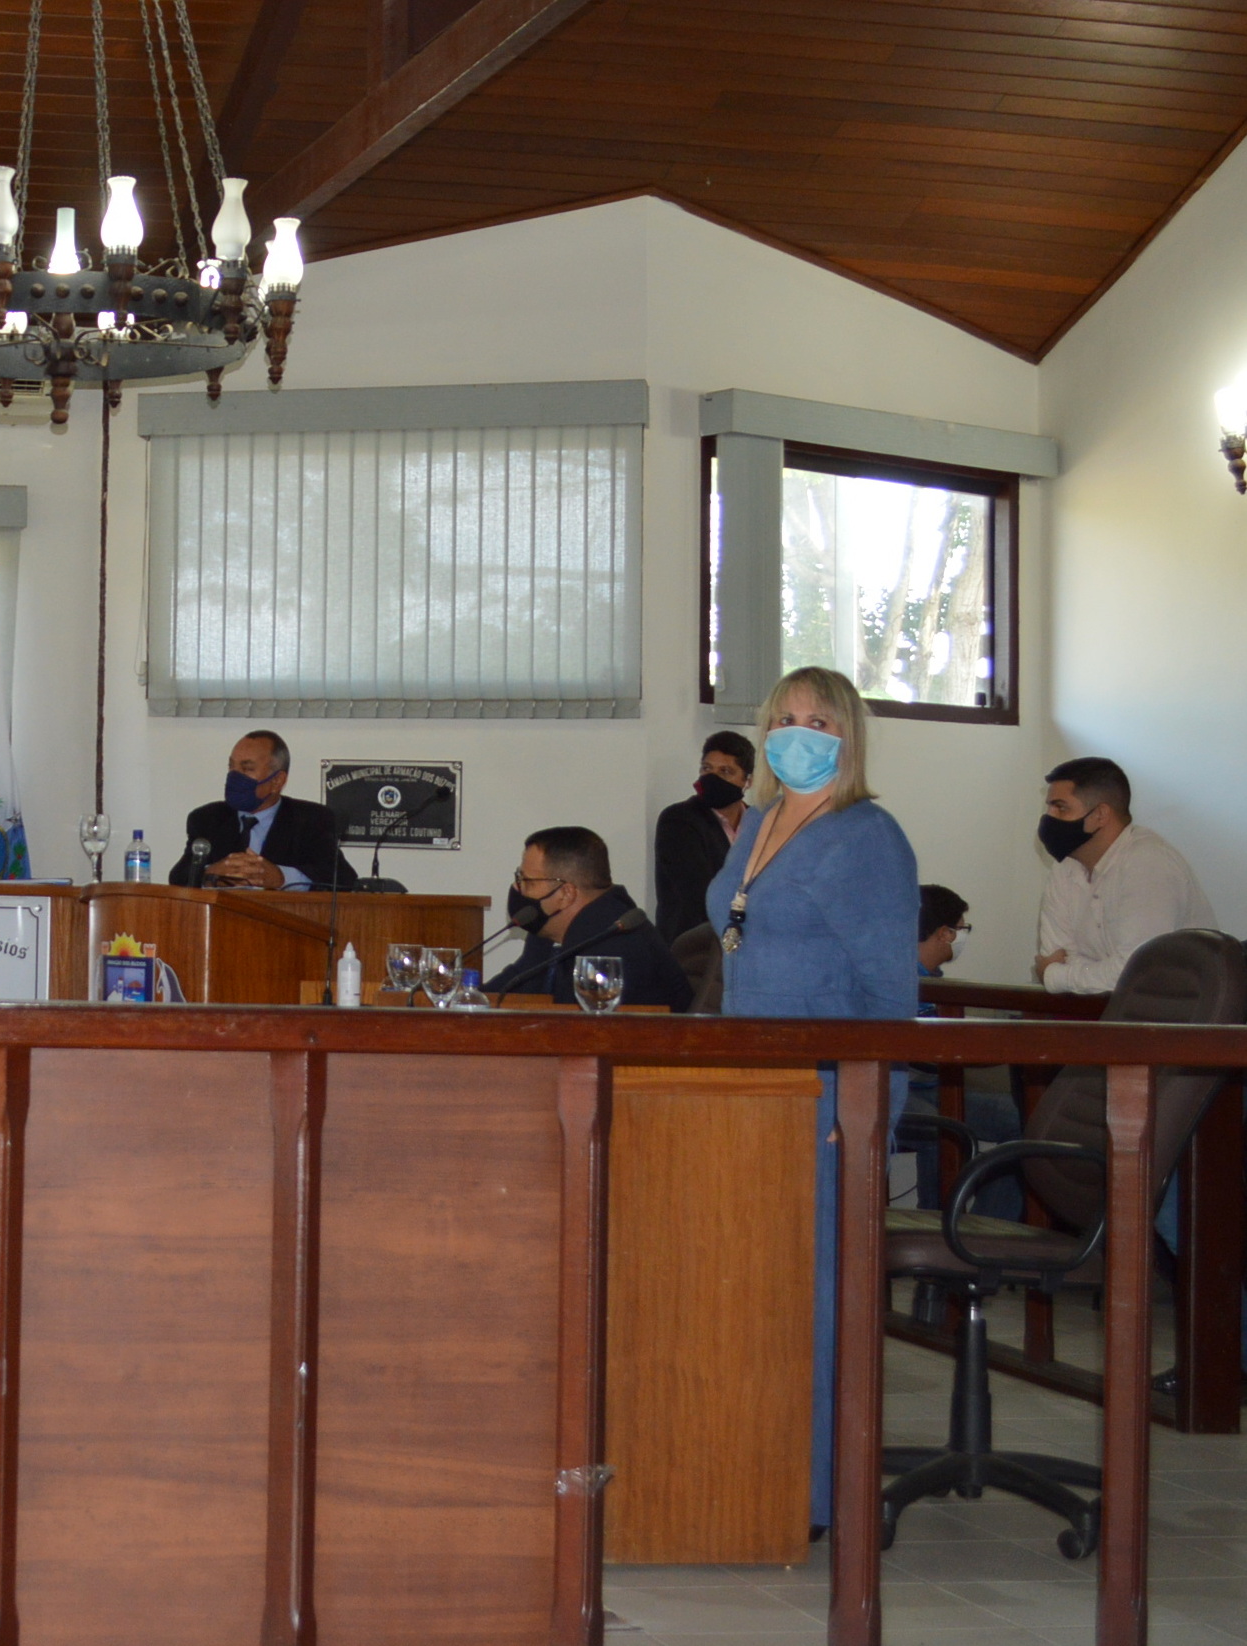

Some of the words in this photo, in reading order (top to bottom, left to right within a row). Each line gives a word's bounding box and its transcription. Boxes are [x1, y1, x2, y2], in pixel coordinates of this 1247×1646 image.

[352, 767, 383, 780] MUNICIPAL
[384, 766, 393, 775] DE
[422, 772, 435, 783] DOS
